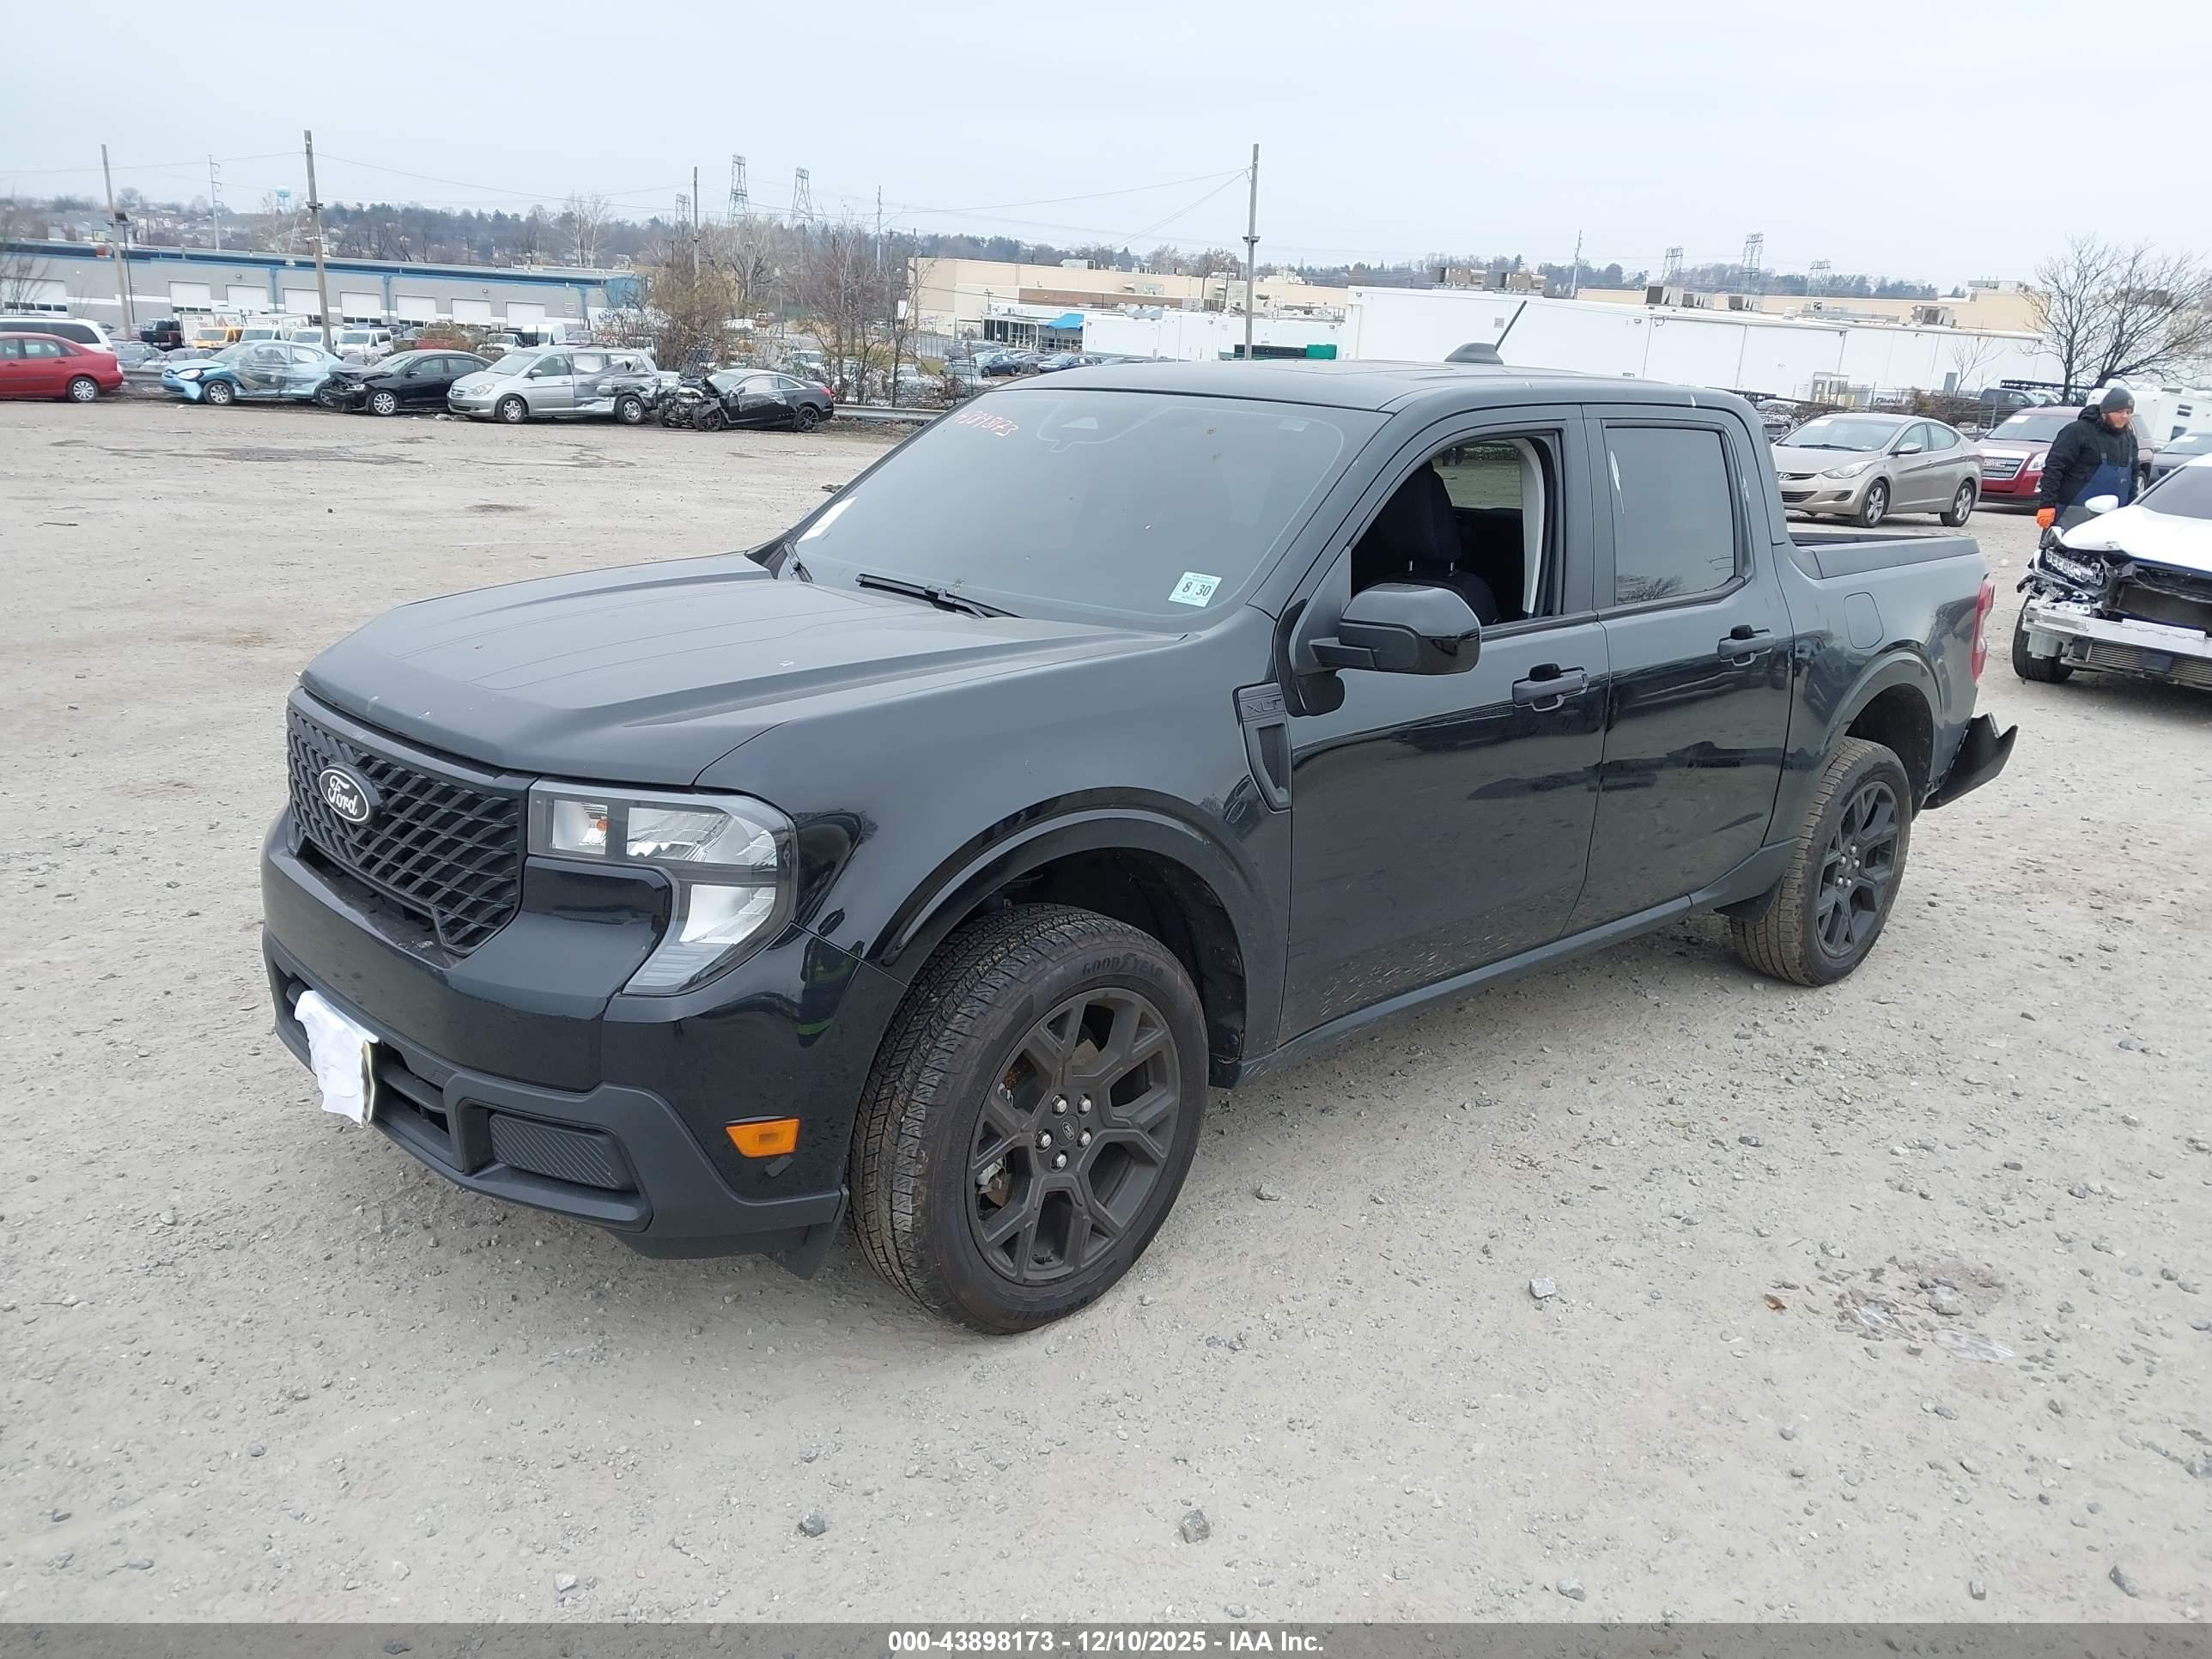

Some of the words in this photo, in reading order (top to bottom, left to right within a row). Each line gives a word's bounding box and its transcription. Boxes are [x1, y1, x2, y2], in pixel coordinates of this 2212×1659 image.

[1182, 581, 1193, 592] 8
[1195, 584, 1212, 597] 30
[1247, 698, 1282, 714] XLT
[327, 775, 358, 816] Ford
[1082, 952, 1164, 978] GOODYEAR
